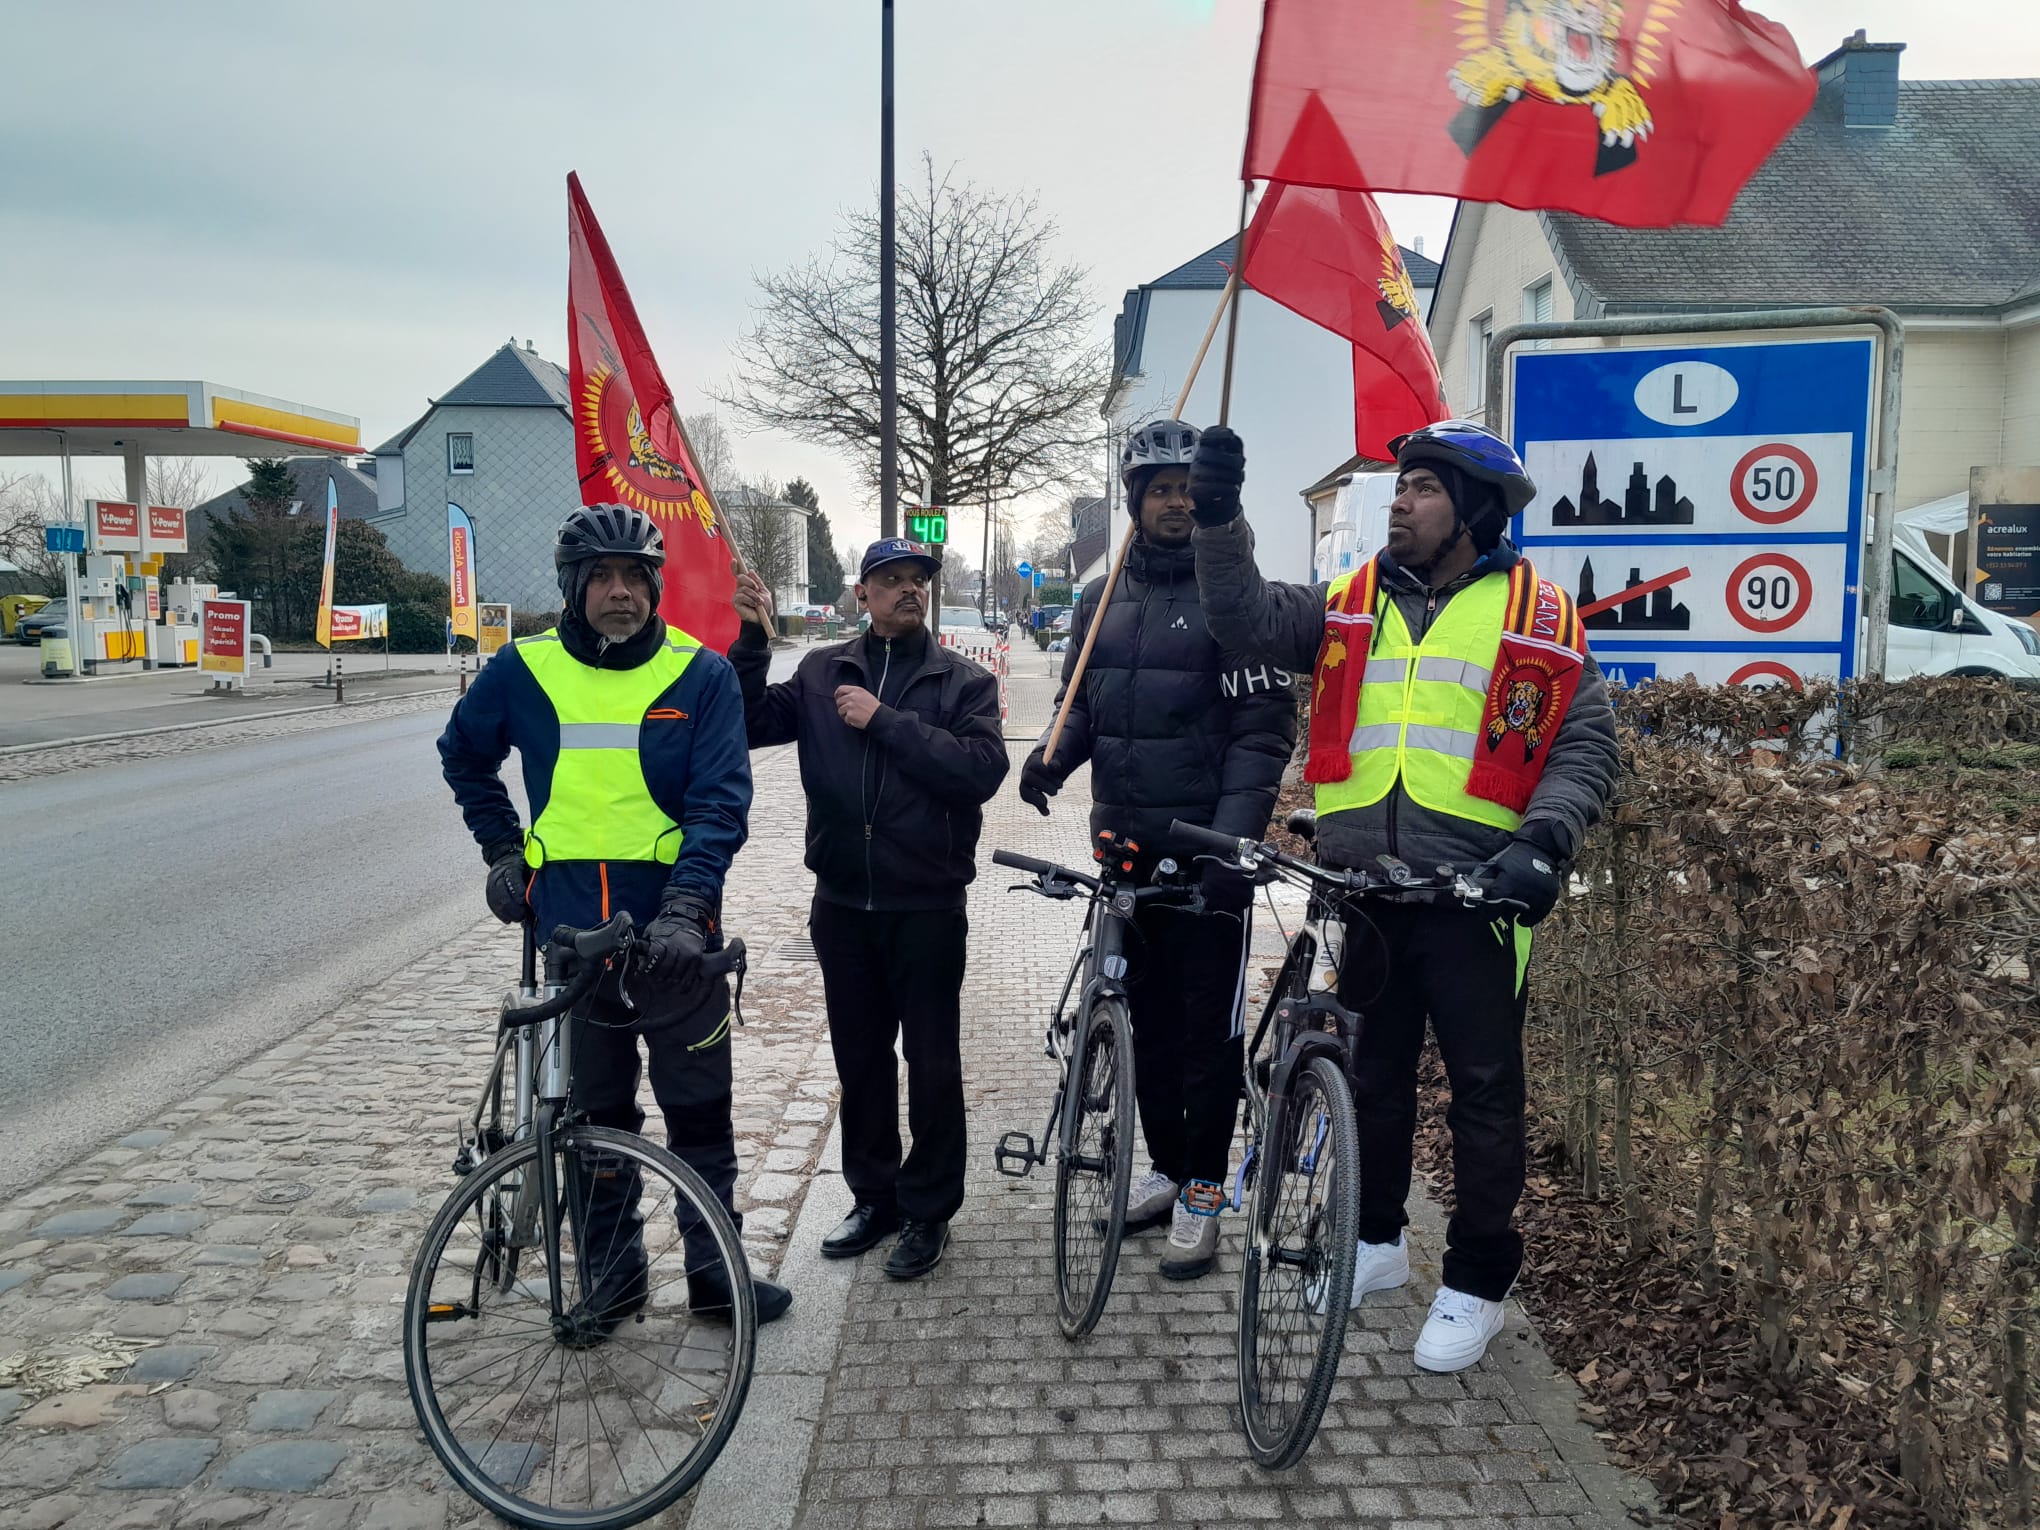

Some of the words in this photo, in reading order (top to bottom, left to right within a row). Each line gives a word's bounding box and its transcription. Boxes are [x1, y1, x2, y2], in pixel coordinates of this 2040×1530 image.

[1673, 374, 1698, 414] L
[1752, 466, 1796, 501] 50
[101, 513, 133, 526] V-Power
[152, 517, 180, 529] V-Power
[1987, 523, 2028, 534] acrealux
[914, 517, 945, 542] 40
[1747, 576, 1790, 610] 90
[207, 609, 241, 621] Promo
